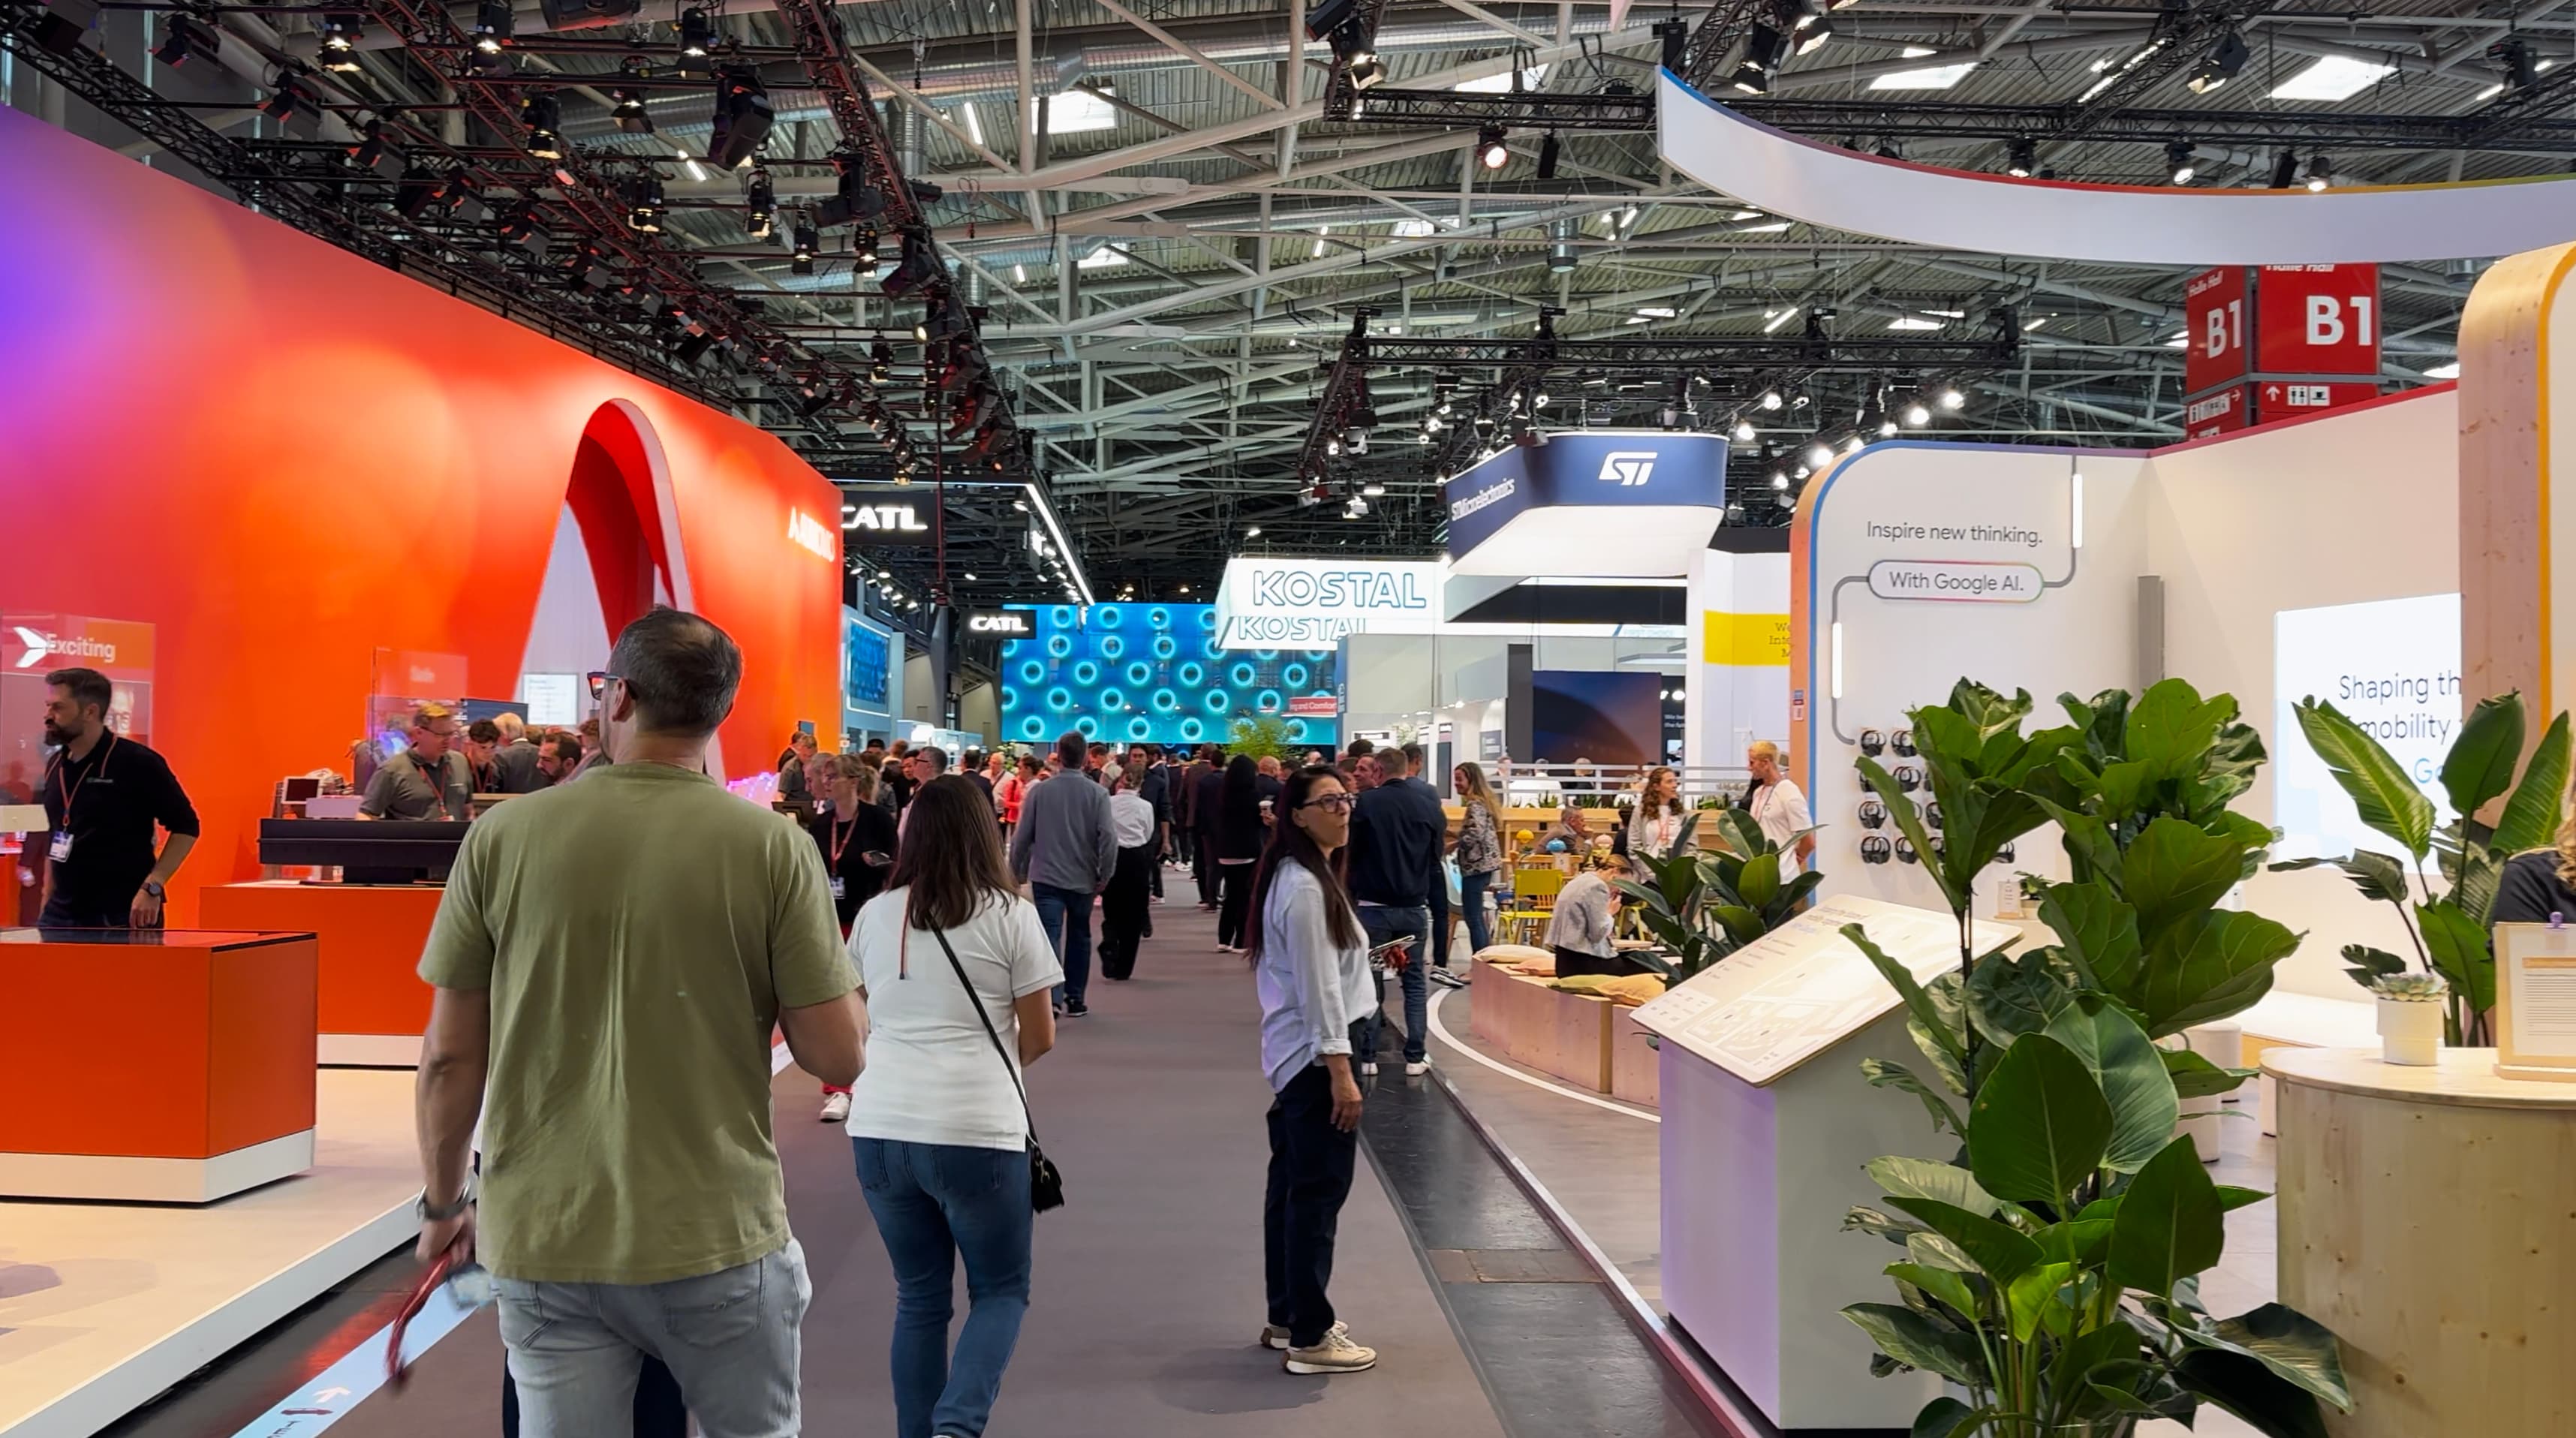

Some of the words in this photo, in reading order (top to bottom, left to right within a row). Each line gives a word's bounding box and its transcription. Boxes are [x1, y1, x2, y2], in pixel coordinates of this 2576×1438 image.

[2207, 298, 2241, 360] B1
[2306, 295, 2372, 346] B1
[1867, 521, 1926, 543] Inspire
[1929, 527, 1967, 540] new
[1970, 525, 2043, 548] thinking.
[1253, 570, 1427, 609] KOSTAL
[1888, 570, 1930, 589] With
[1934, 573, 1998, 594] Google
[2001, 574, 2025, 591] AI.
[970, 616, 1031, 631] CATL
[47, 633, 116, 663] Exciting
[2339, 672, 2429, 705] Shaping
